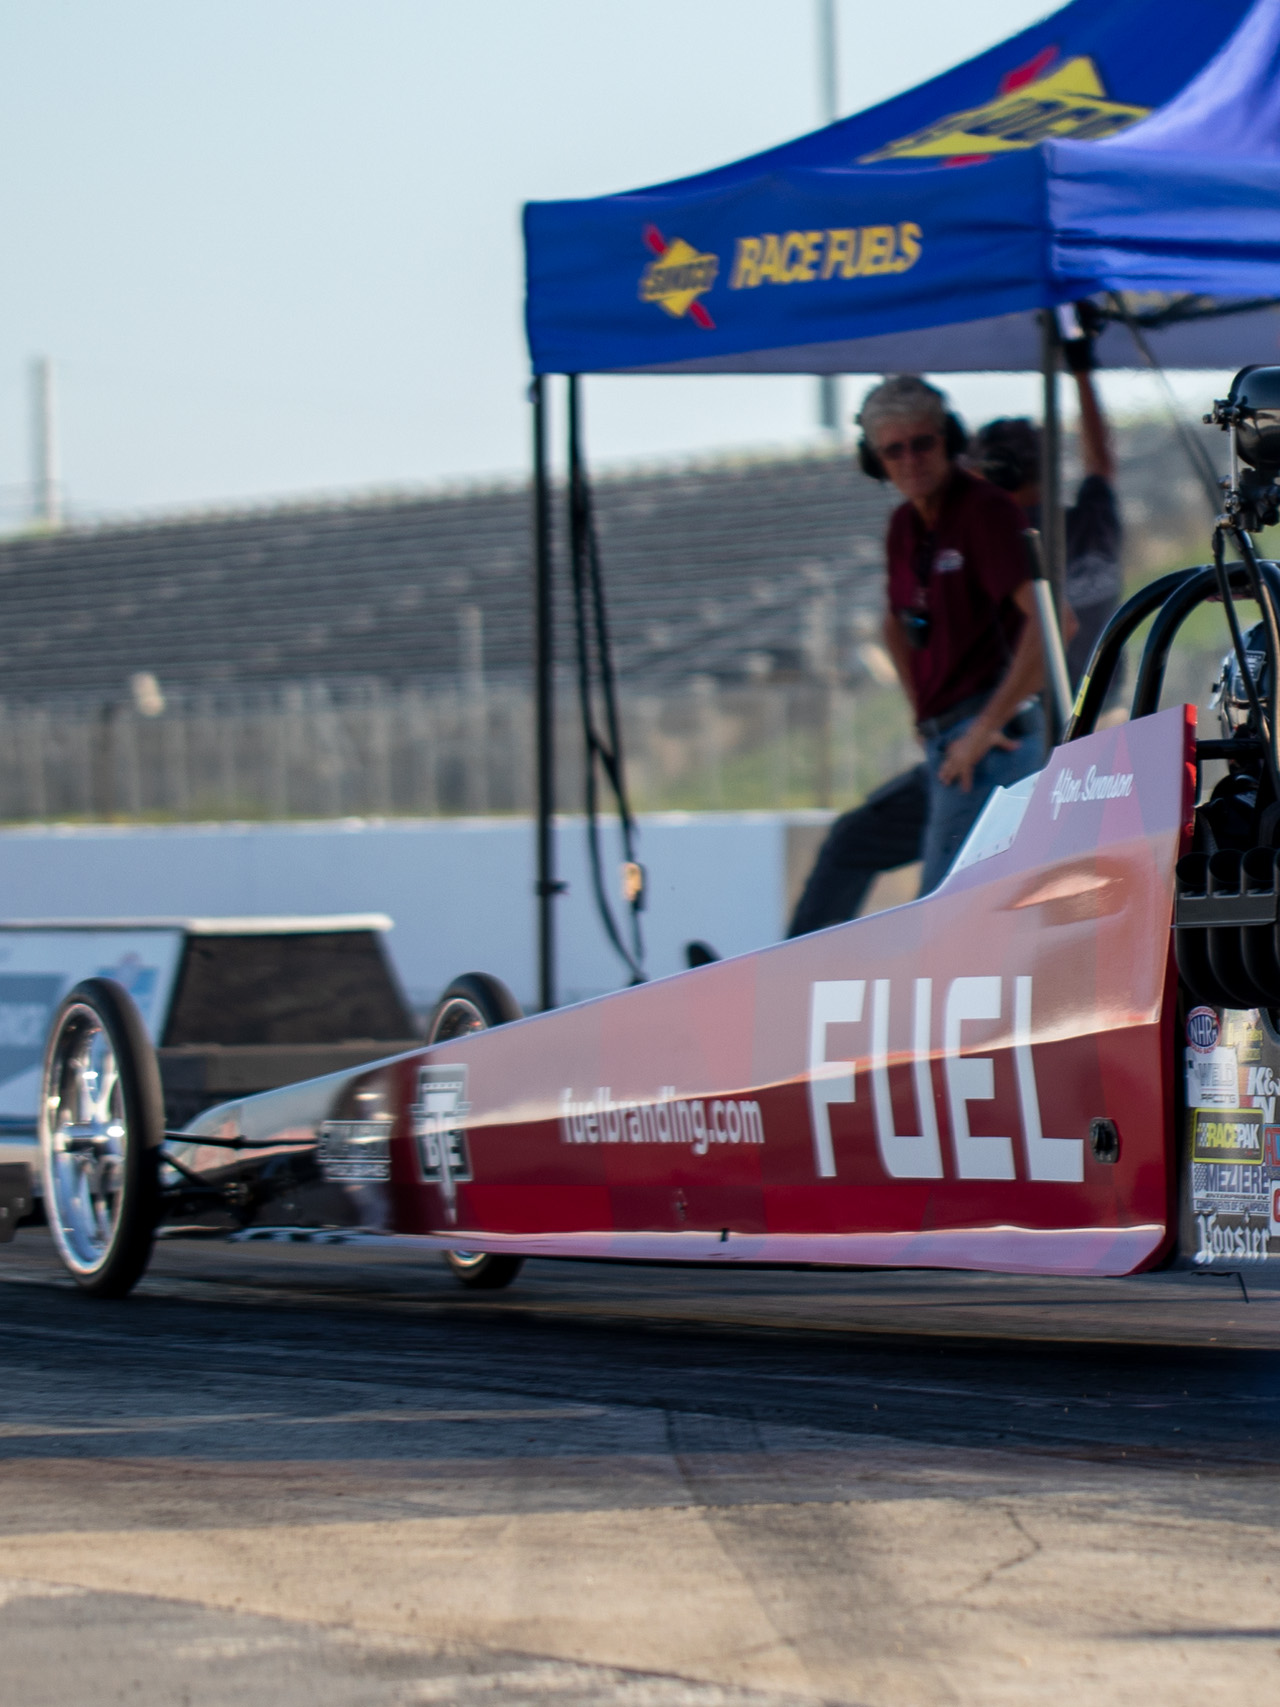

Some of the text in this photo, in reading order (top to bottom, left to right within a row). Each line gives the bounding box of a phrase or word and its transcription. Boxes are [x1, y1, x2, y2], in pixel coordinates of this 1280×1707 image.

[731, 221, 922, 289] RACE FUELS
[1189, 1015, 1218, 1046] NHRA
[809, 976, 1084, 1183] FUEL
[560, 1086, 765, 1155] fuelbranding.com
[1207, 1122, 1260, 1149] RACEPAK
[1194, 1211, 1271, 1262] Hoosier
